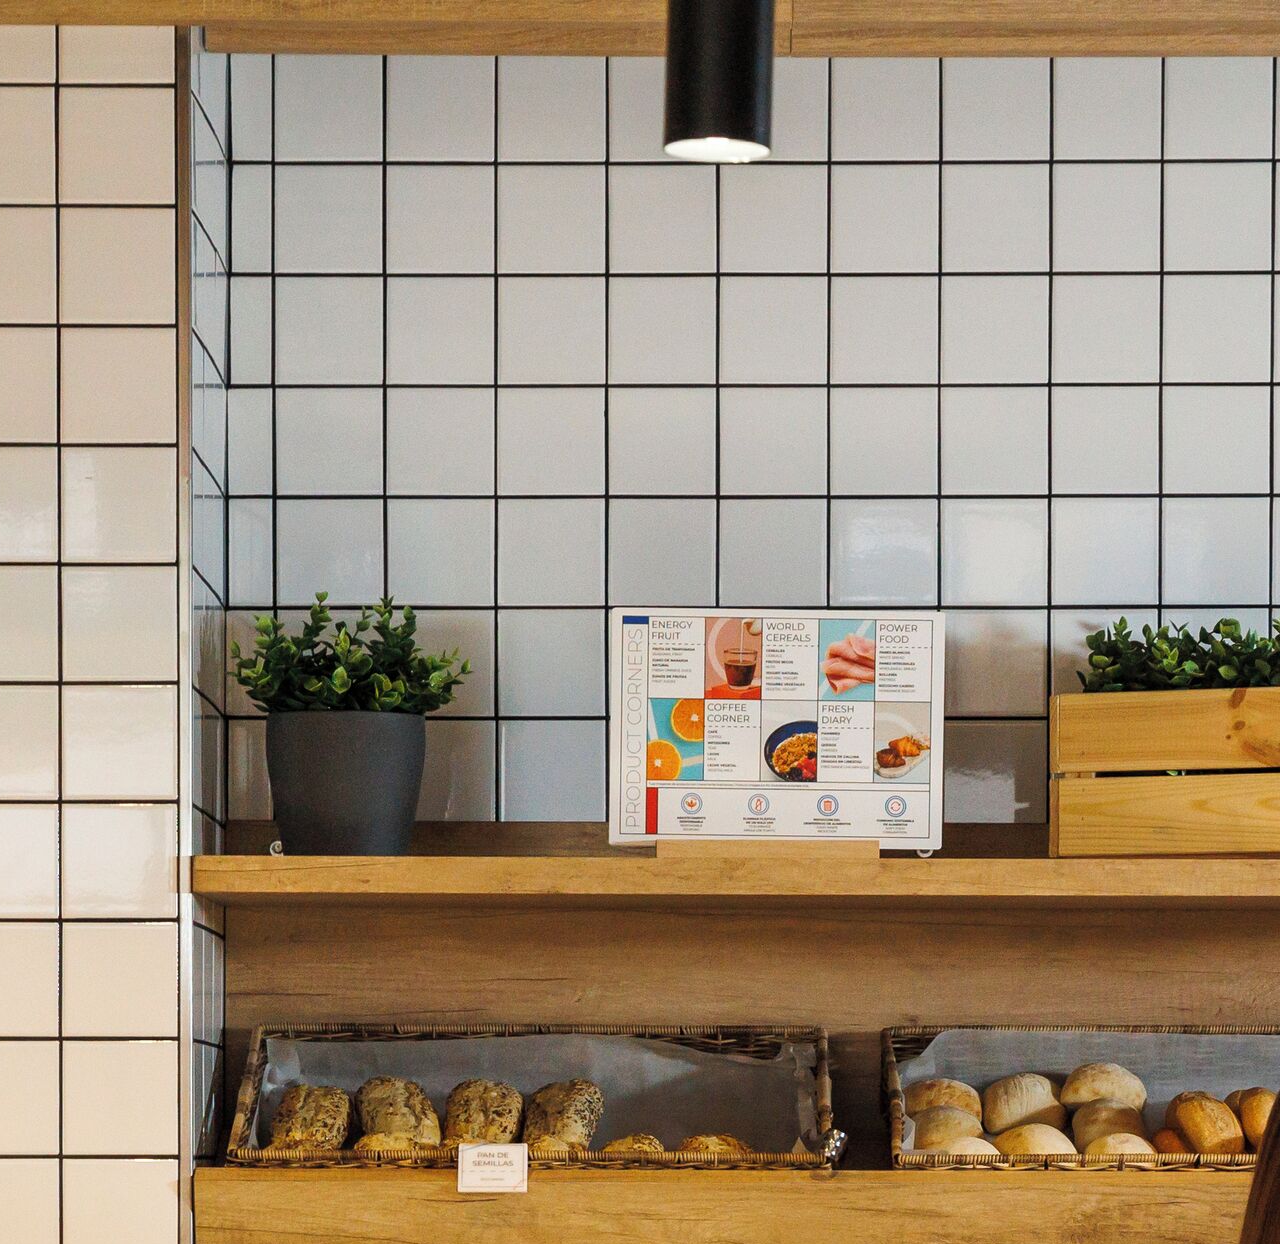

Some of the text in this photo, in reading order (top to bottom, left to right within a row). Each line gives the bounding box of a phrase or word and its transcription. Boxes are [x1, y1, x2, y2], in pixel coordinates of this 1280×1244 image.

[651, 620, 693, 629] ENERGY
[766, 622, 805, 631] WORLD
[879, 623, 918, 632] POWER
[651, 631, 681, 640] FRUIT
[765, 634, 811, 642] CEREALS
[879, 634, 909, 643] FOOD
[707, 703, 747, 712] COFFEE
[821, 704, 855, 713] FRESH
[707, 714, 750, 723] CORNER
[821, 716, 853, 724] DIARY
[625, 628, 643, 827] PRODUCT CORNERS
